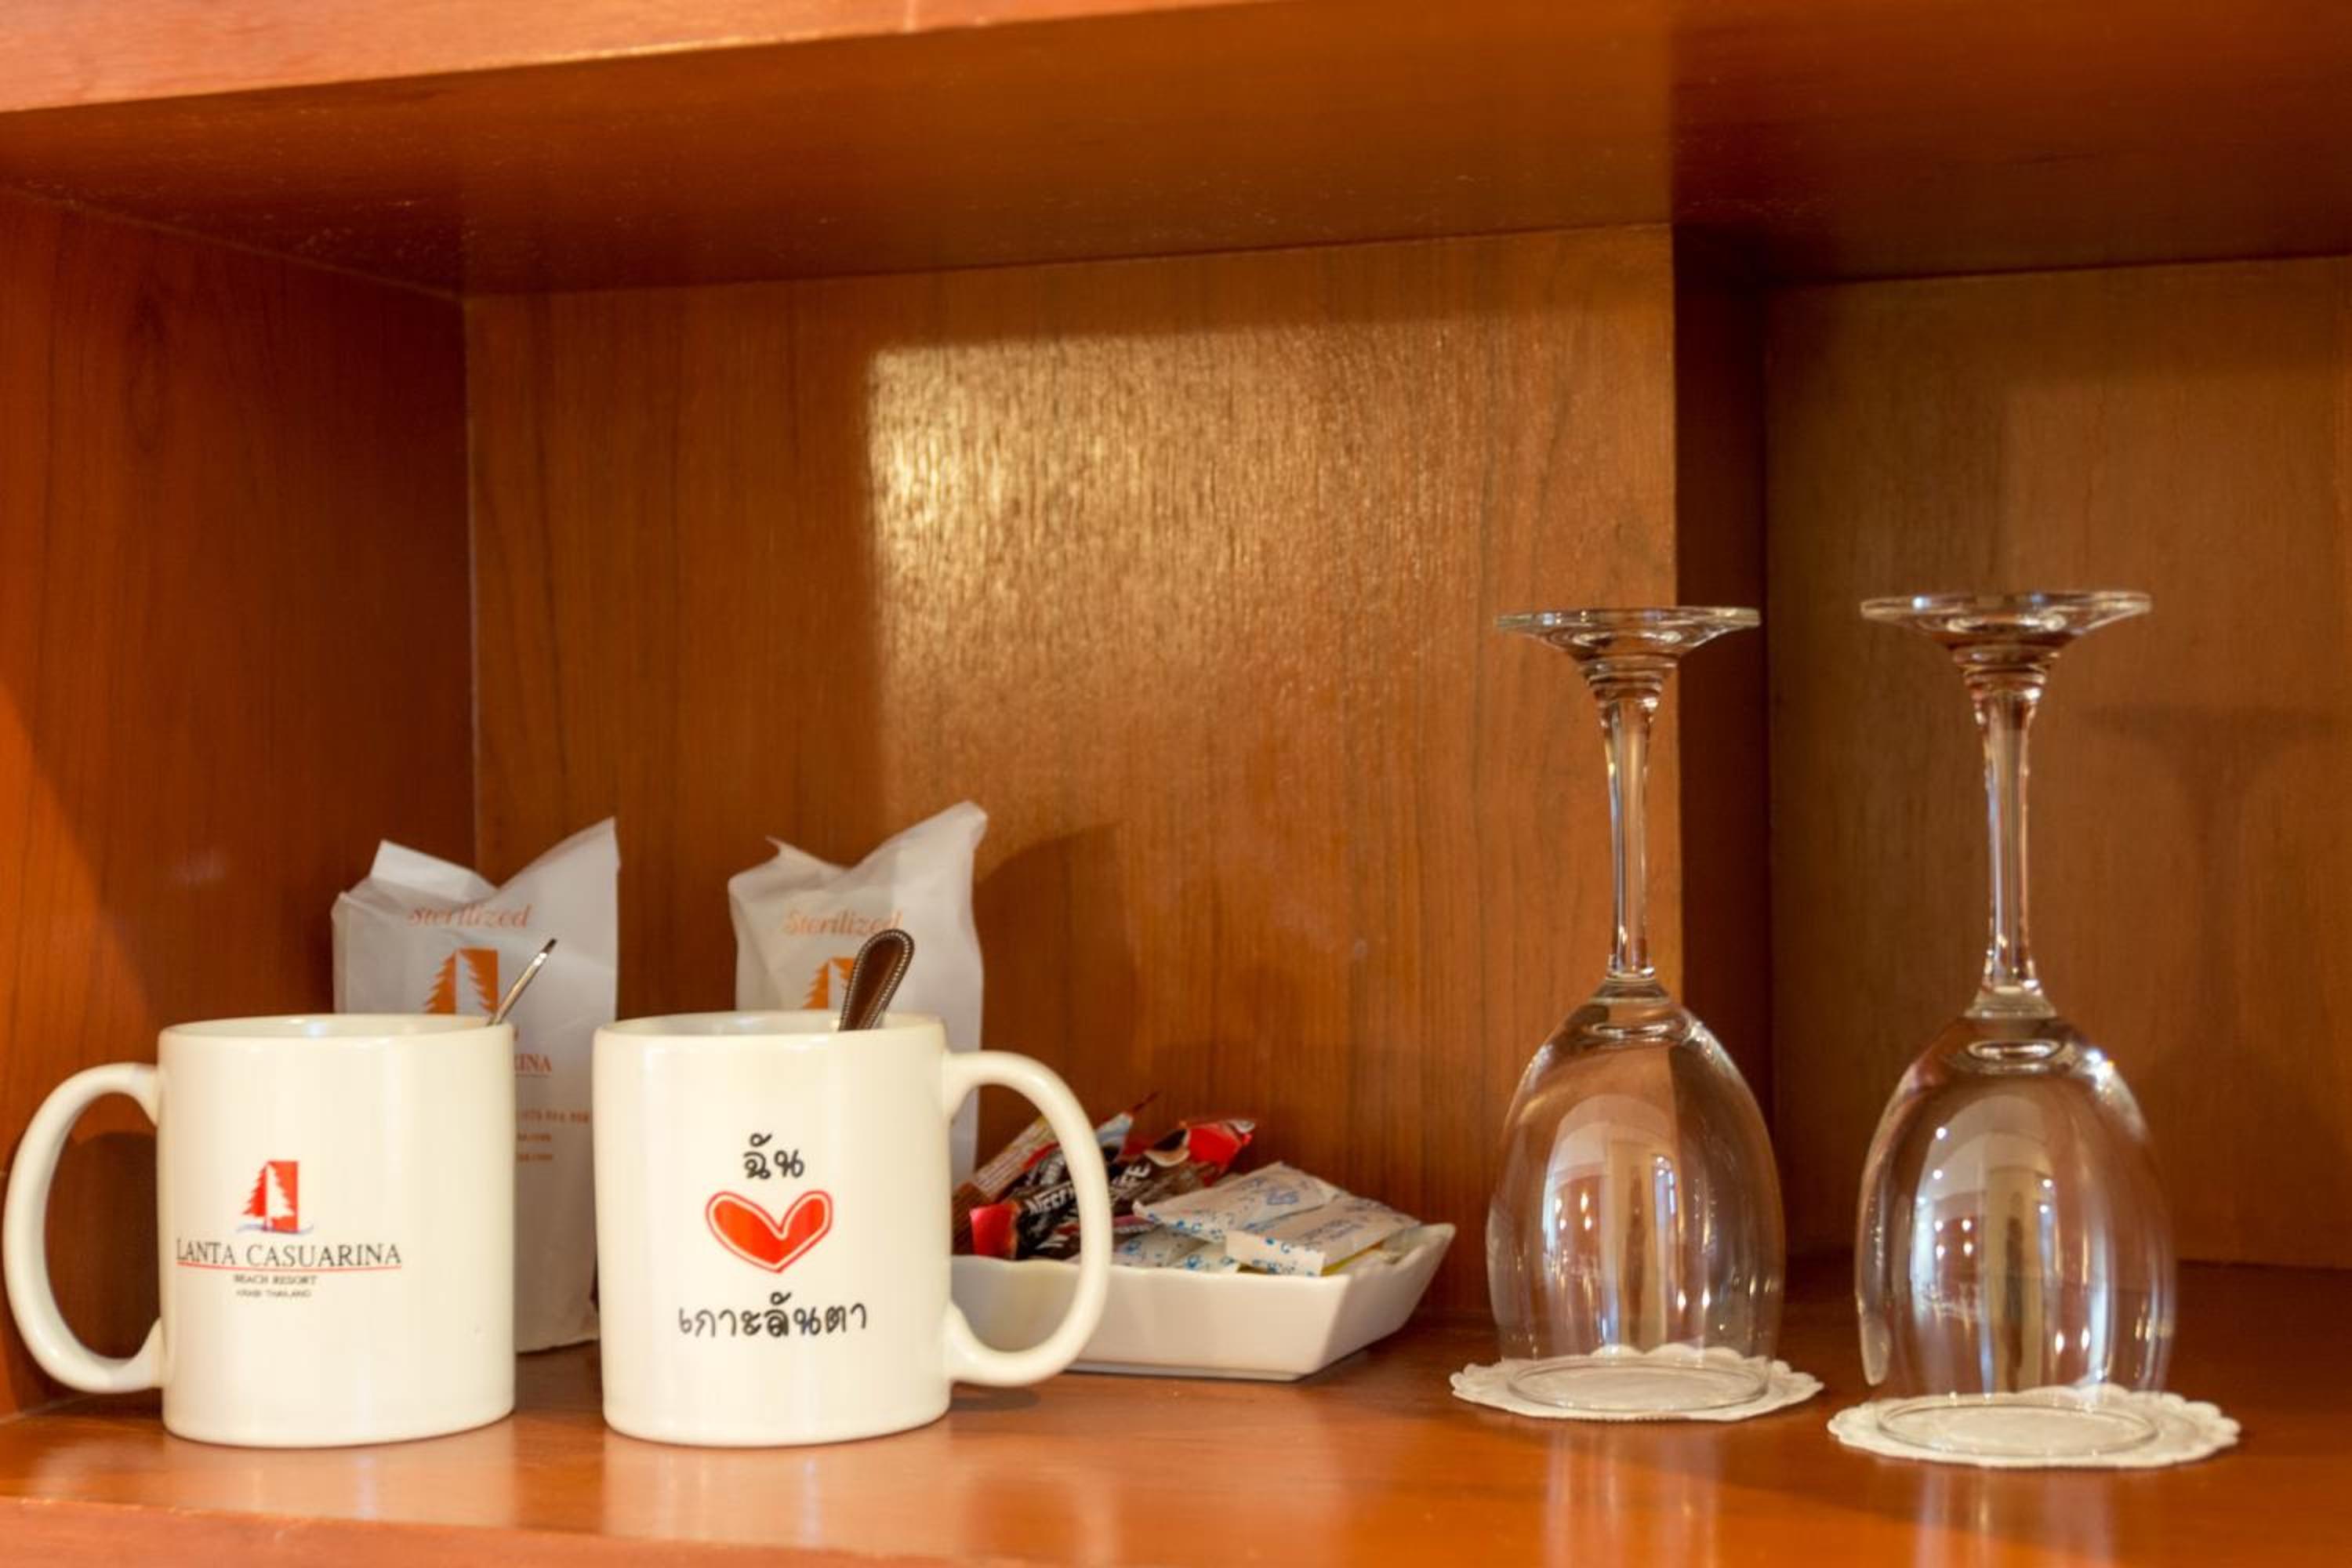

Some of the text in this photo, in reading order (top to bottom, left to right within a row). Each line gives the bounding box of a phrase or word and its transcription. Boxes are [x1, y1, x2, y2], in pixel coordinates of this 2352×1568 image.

[408, 902, 533, 928] Sterilized
[785, 909, 903, 935] Sterilized
[743, 1132, 804, 1180] ฉัน
[176, 1237, 401, 1269] LANTA CASUARINA
[234, 1273, 318, 1286] BEACH RESORT
[678, 1290, 867, 1338] เกาะลันตา
